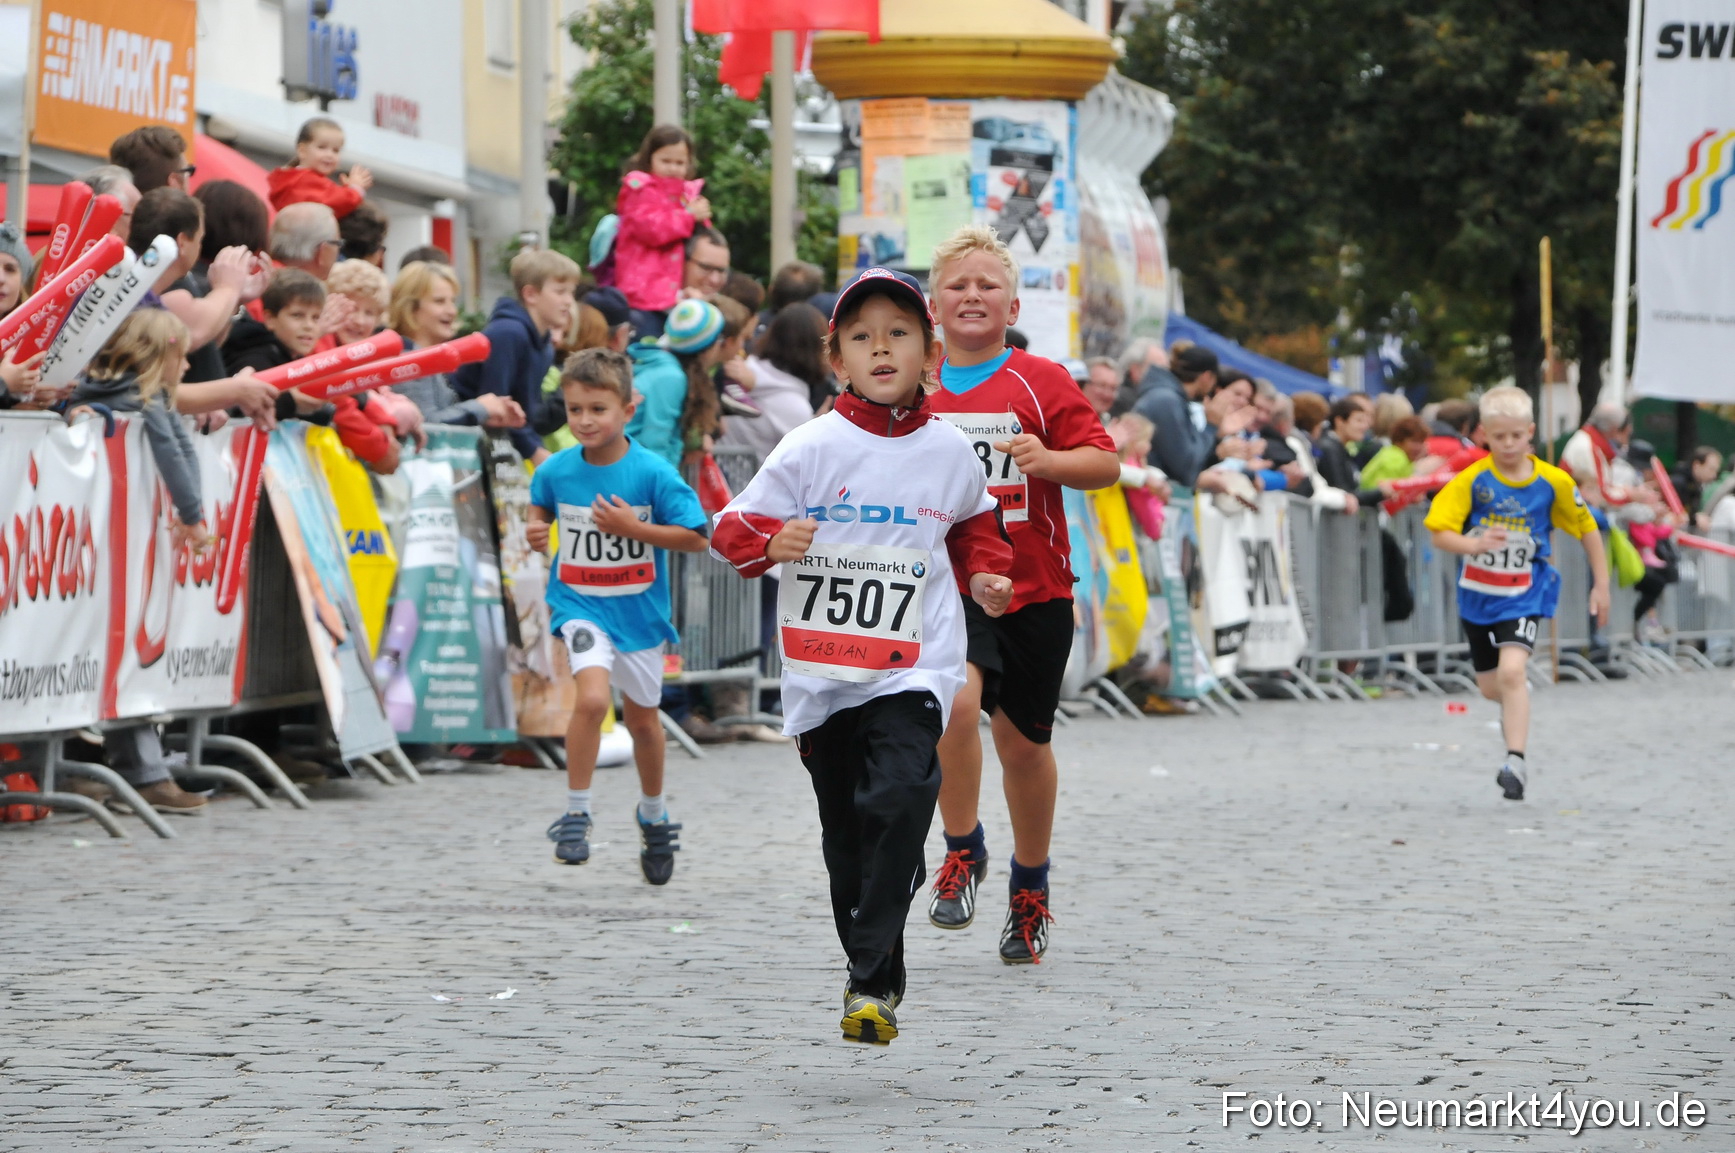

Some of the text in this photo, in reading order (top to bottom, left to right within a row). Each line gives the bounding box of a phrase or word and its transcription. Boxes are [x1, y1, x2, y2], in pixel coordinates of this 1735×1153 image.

[1657, 24, 1735, 58] SW
[0, 298, 59, 350] Audi BKK
[288, 354, 341, 379] Audi BKK
[326, 373, 383, 395] Audi BKK
[567, 528, 645, 562] 7030
[581, 570, 630, 583] Lennart
[837, 557, 906, 575] Neumarkt
[797, 573, 916, 632] 7507
[911, 630, 918, 640] K
[1515, 616, 1537, 643] 10
[802, 639, 867, 660] FABIAN
[0, 659, 66, 707] tbayerns
